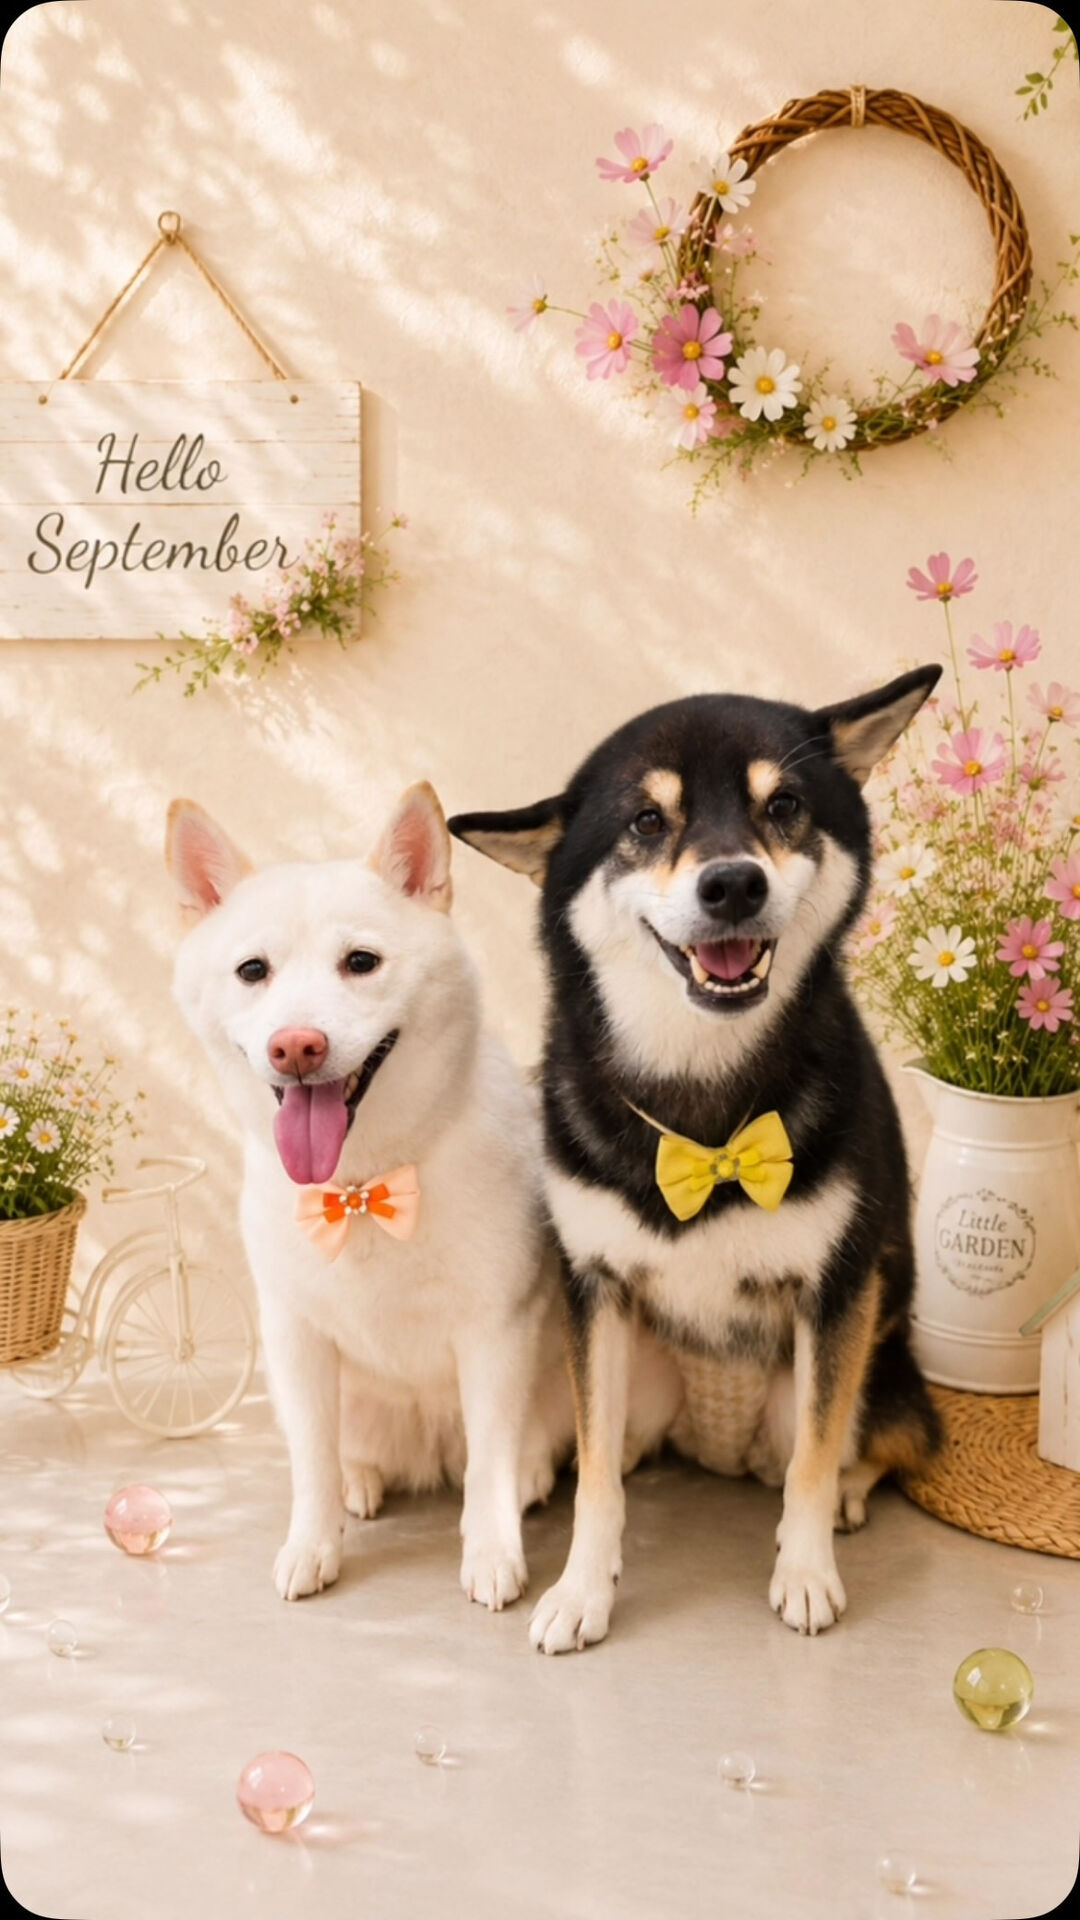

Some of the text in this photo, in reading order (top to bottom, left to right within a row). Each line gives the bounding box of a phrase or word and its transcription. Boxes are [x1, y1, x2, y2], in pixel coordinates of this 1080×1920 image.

[95, 432, 229, 495] Hello
[27, 512, 300, 590] September
[939, 1228, 1028, 1260] GARDEN
[958, 1209, 1008, 1233] Little
